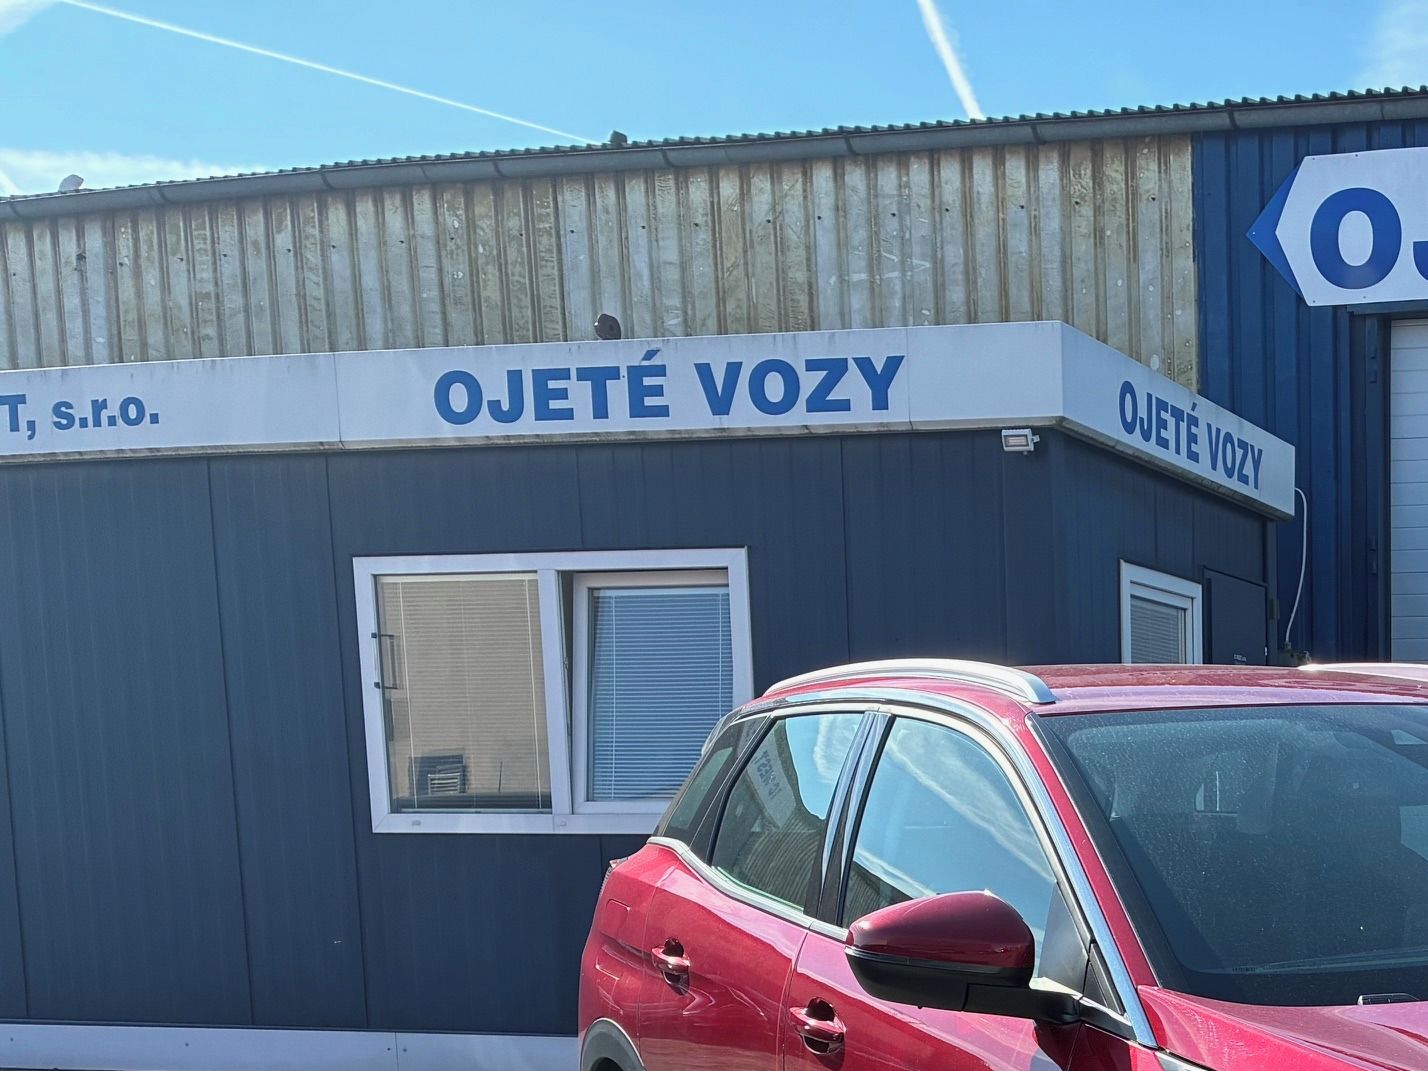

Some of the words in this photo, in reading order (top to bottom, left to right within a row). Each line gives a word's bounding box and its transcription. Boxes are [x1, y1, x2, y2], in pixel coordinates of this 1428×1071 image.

[51, 396, 160, 431] s.r.o.
[433, 349, 671, 425] OJETÉ
[693, 355, 905, 416] VOZY
[1118, 380, 1200, 464] OJETÉ
[1206, 423, 1263, 490] VOZY
